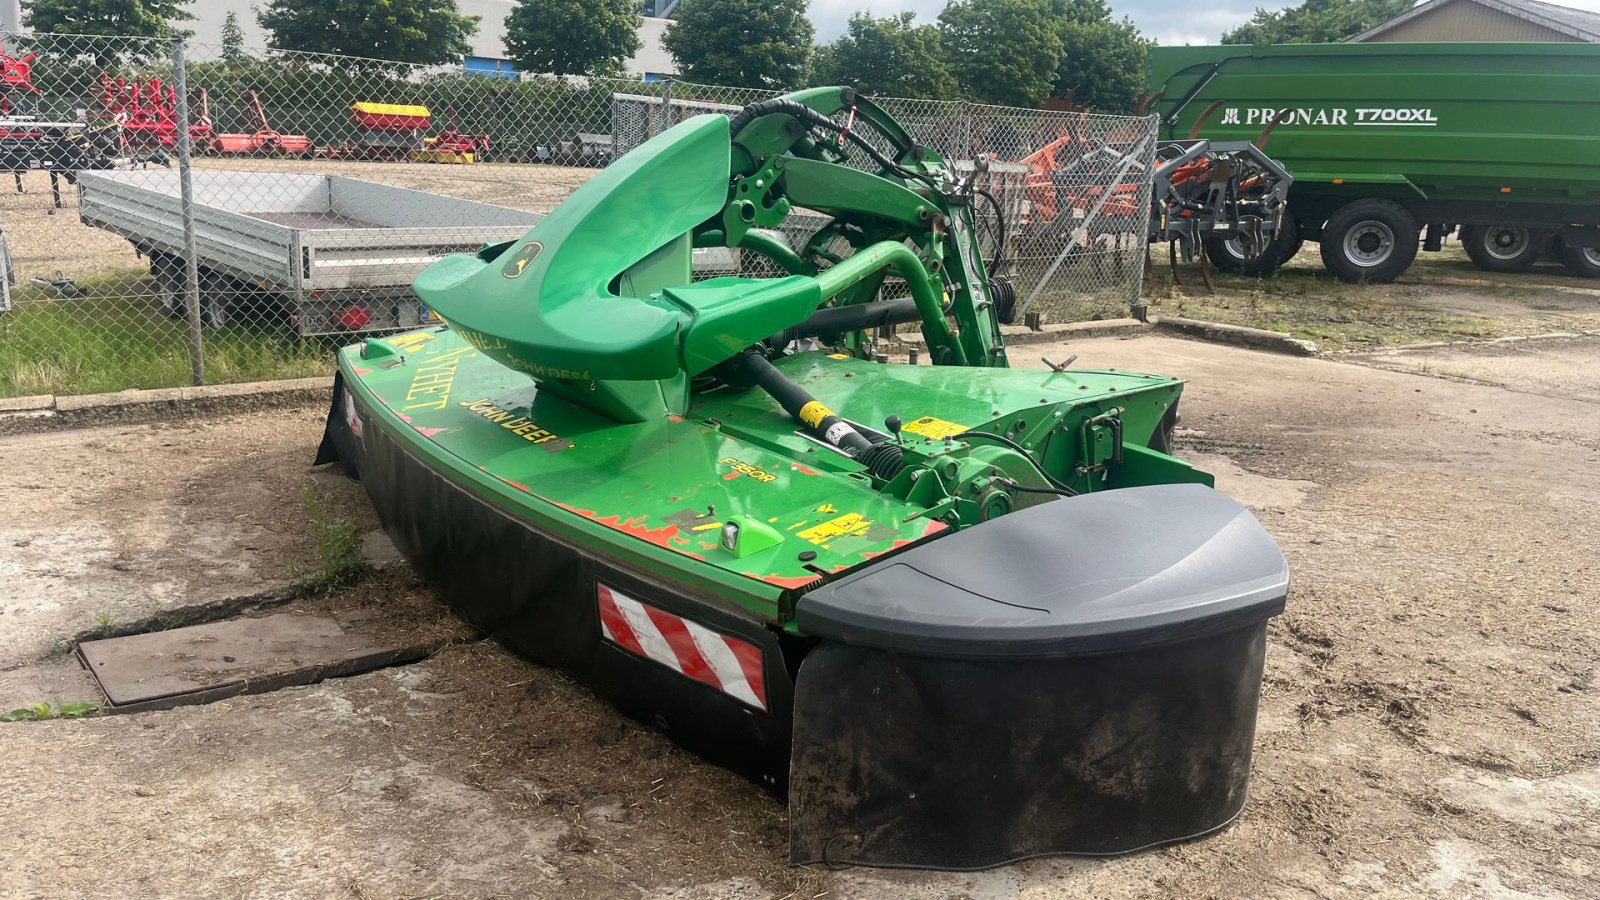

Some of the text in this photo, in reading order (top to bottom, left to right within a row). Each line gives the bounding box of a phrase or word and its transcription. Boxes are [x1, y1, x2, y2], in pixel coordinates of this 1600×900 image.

[1245, 107, 1438, 126] PRONAR T700XL
[459, 398, 516, 424] JOHN
